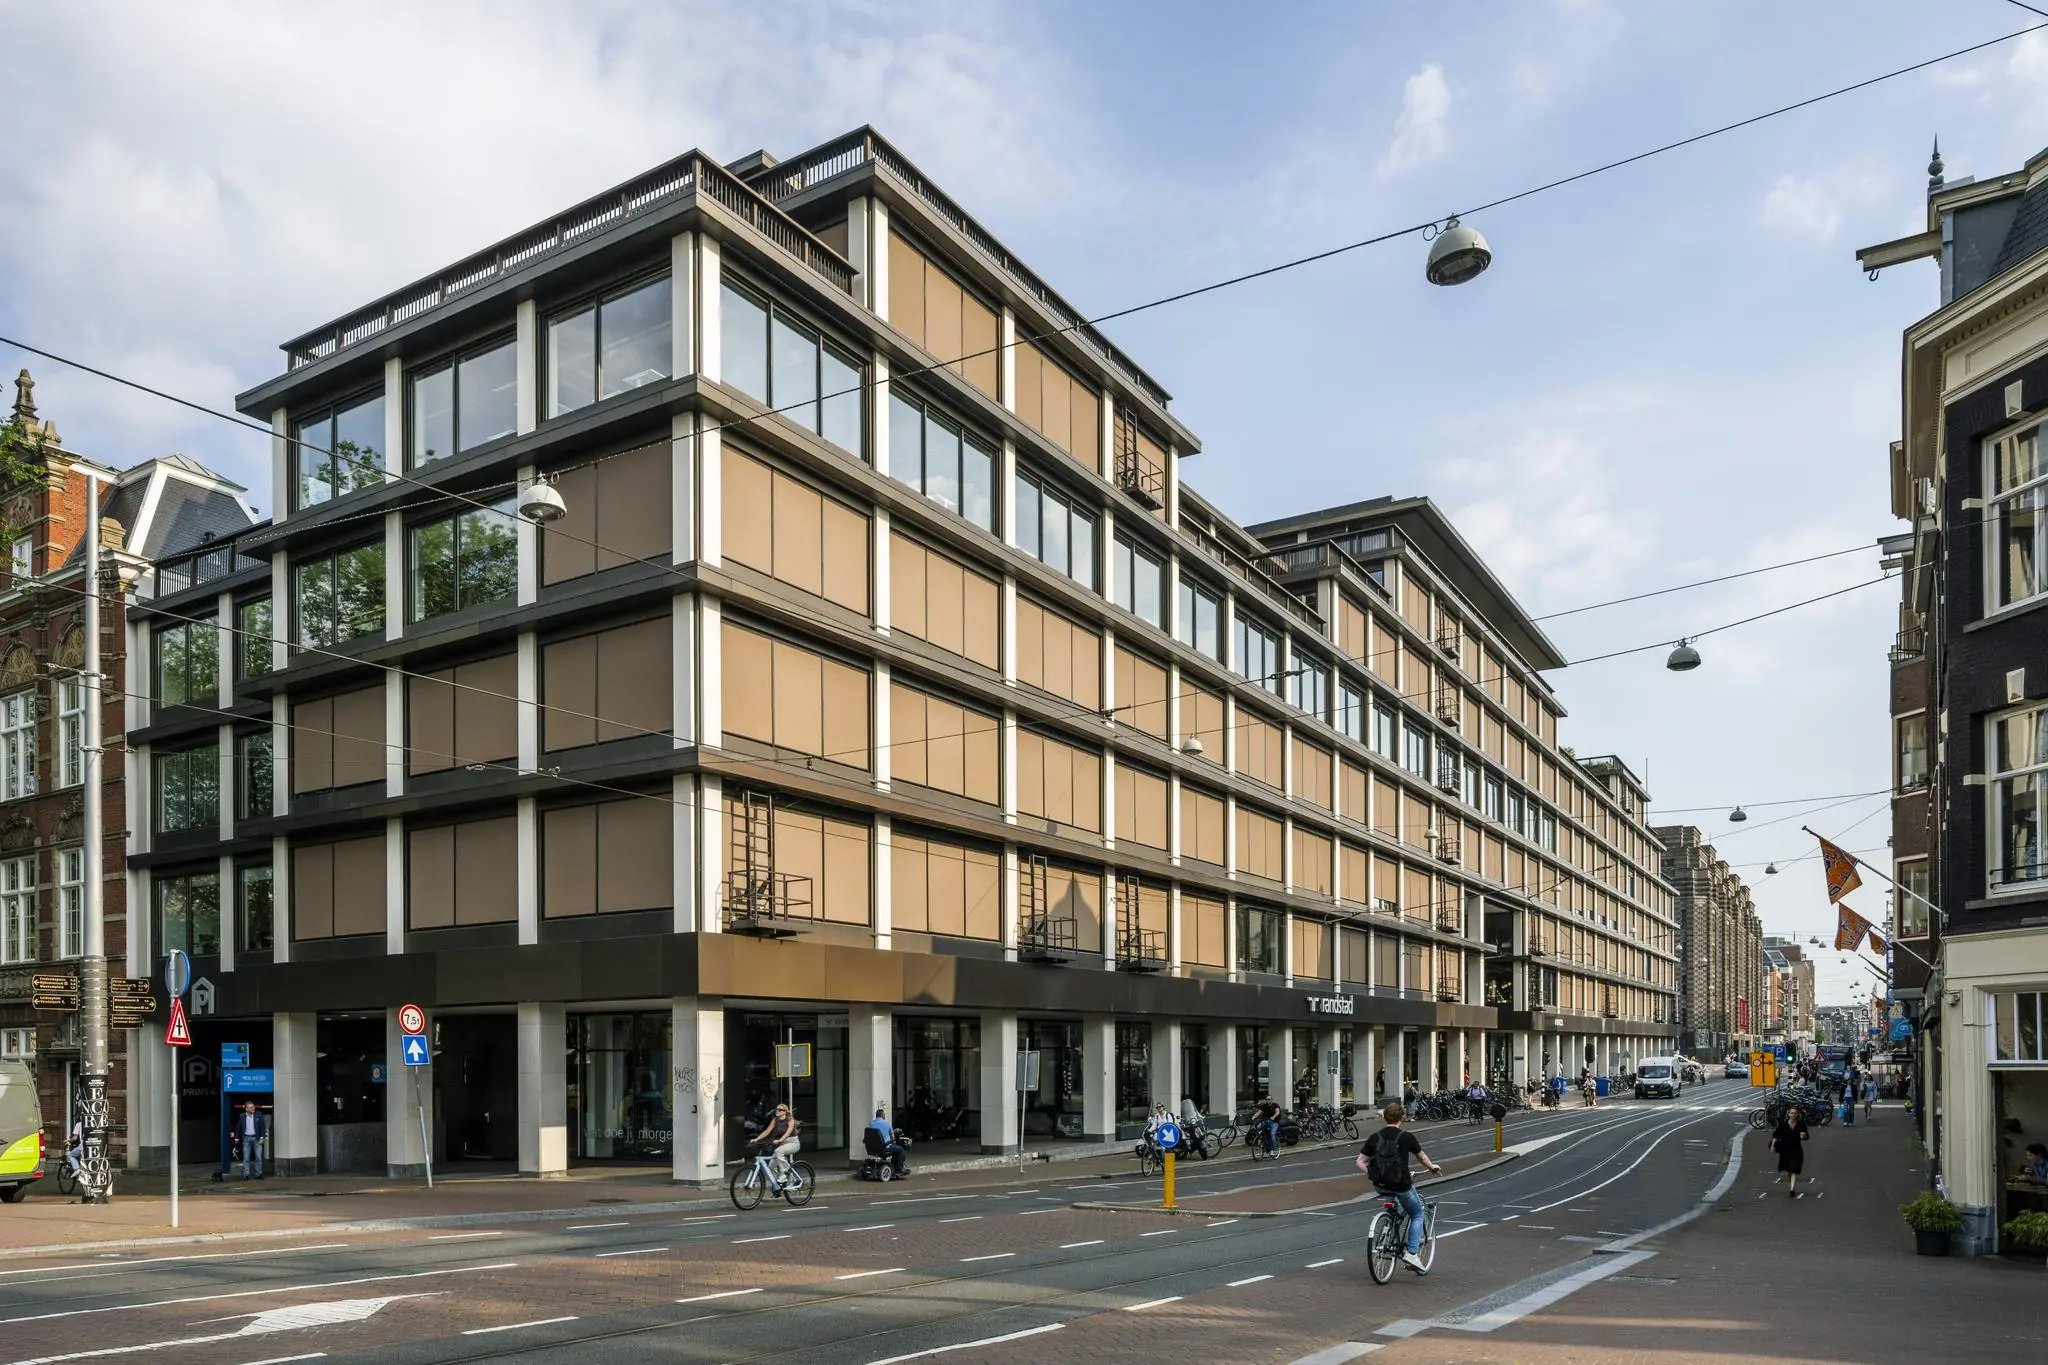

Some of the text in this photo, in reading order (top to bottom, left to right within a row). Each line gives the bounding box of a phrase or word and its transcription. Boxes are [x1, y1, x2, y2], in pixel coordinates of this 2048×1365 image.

[1321, 994, 1354, 1015] randstad
[1776, 1047, 1784, 1056] P
[183, 1088, 208, 1096] PRINS
[604, 1127, 624, 1139] doe
